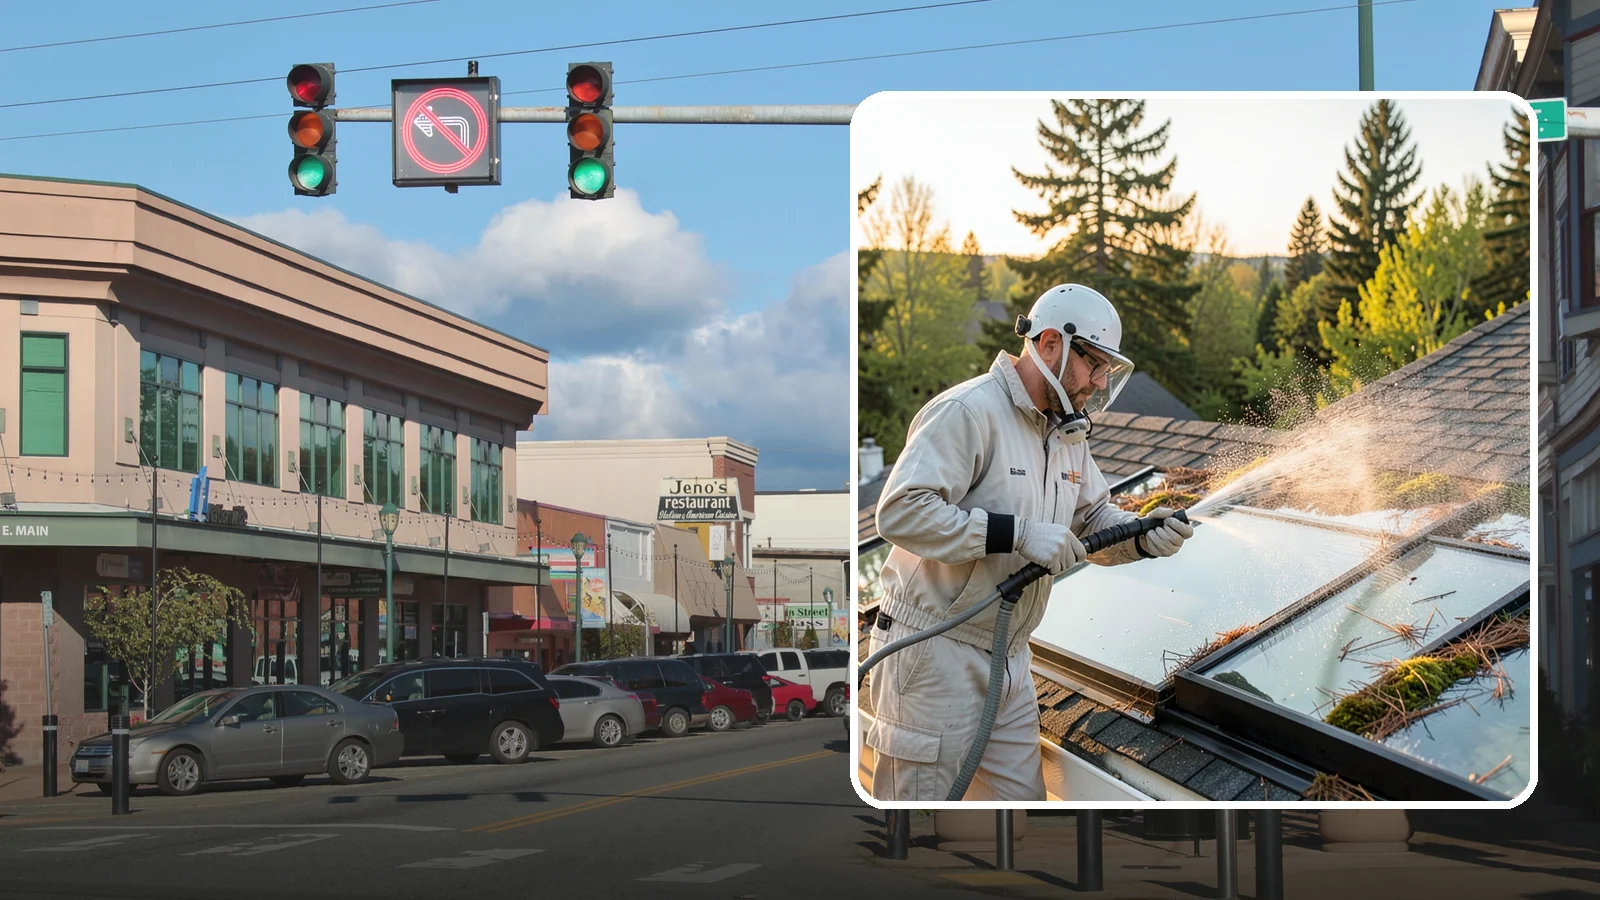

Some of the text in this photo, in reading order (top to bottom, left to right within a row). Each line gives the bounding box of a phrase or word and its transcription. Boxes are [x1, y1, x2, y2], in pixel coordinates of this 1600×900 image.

[669, 480, 727, 494] Jeno's
[665, 496, 731, 509] restaurant
[658, 510, 681, 519] Italian
[686, 510, 715, 519] American
[715, 510, 737, 519] Cuisine
[2, 525, 49, 536] E. MAIN
[797, 608, 828, 617] Street
